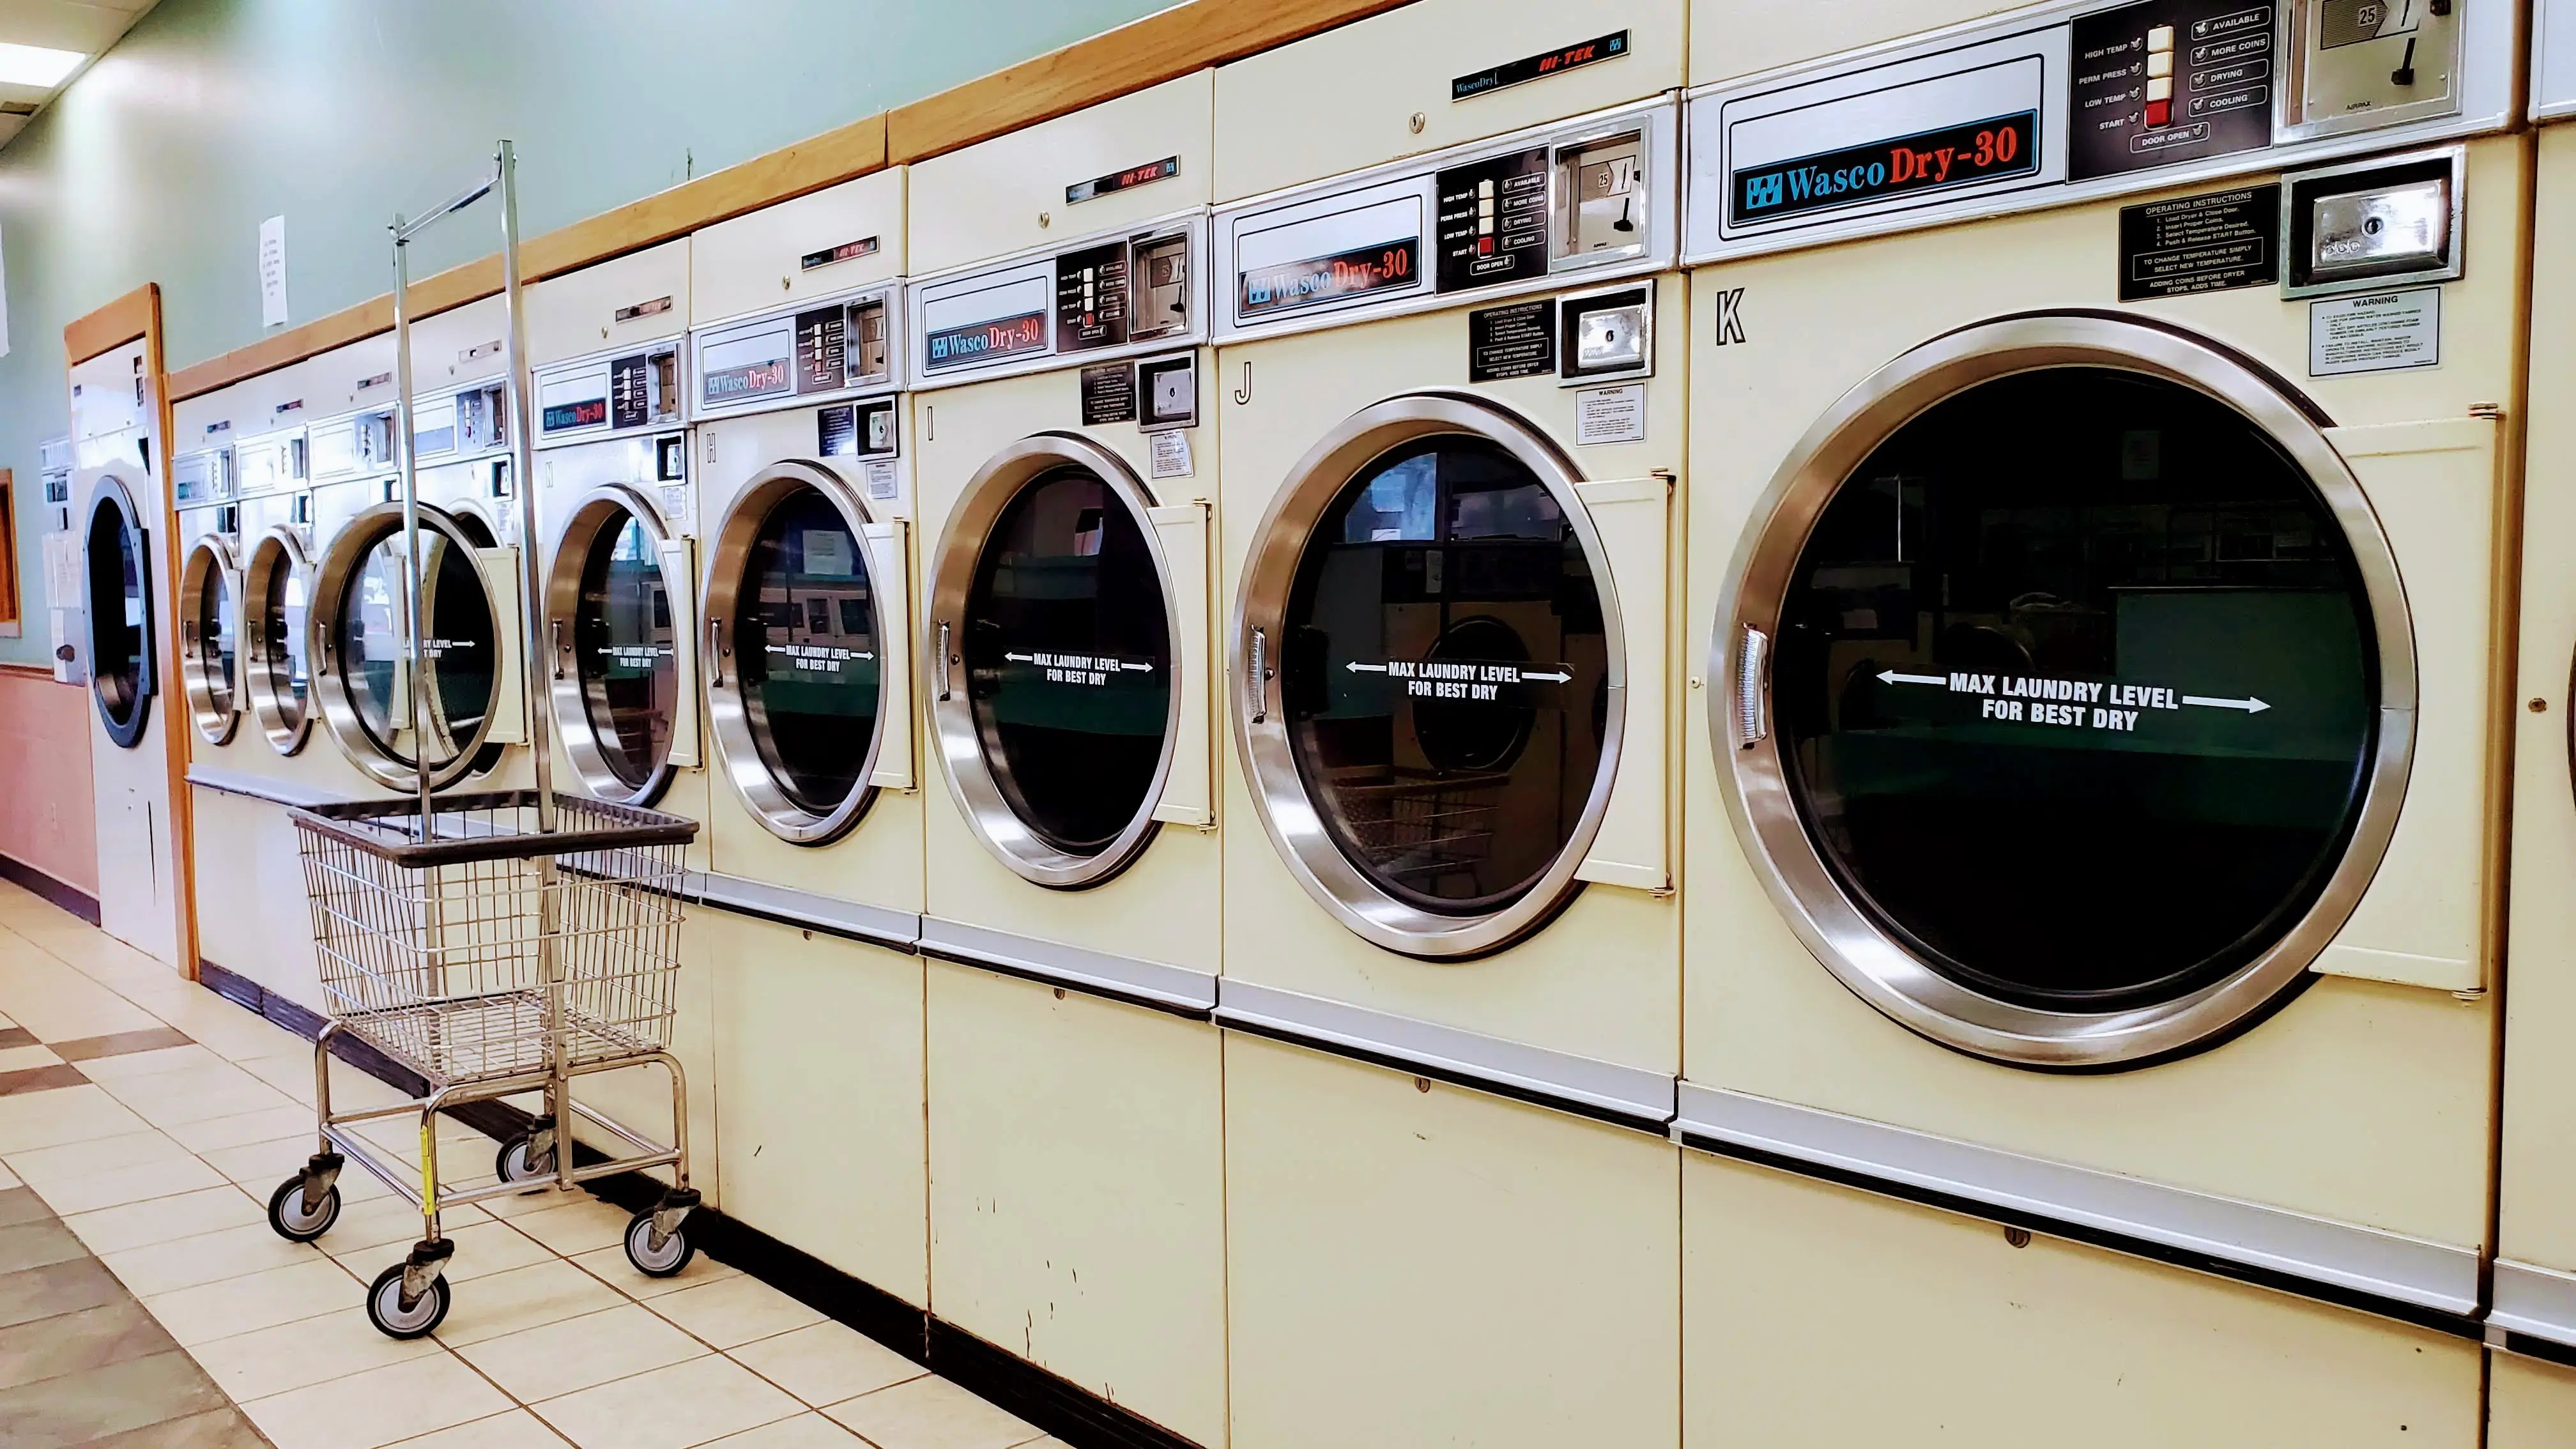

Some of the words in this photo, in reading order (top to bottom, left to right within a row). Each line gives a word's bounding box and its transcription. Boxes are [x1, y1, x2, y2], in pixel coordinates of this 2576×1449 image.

[2213, 13, 2259, 30] AVAILABLE
[2360, 8, 2375, 24] 25
[2085, 50, 2104, 59] HIGH
[2107, 44, 2128, 54] TEMP
[2211, 46, 2236, 56] MORE
[2239, 38, 2266, 50] COINS
[2079, 75, 2100, 84] PERM
[2103, 68, 2126, 79] PRESS
[2211, 69, 2242, 82] DRYING
[2085, 99, 2101, 107] LOW
[2104, 94, 2126, 103] TEMP
[2210, 95, 2248, 108] COOLING
[2099, 119, 2124, 130] START
[2142, 136, 2165, 146] DOOR
[2167, 131, 2189, 141] OPEN
[1514, 177, 1540, 187] AVAILABLE
[1600, 174, 1607, 186] 25
[2146, 201, 2189, 215] OPERATING
[2193, 192, 2252, 207] INSTRUCTIONS
[2186, 225, 2223, 236] Temperature
[2154, 255, 2180, 263] CHANGE
[2183, 249, 2227, 260] TEMPERATURE
[2196, 273, 2221, 282] BEFORE
[2353, 296, 2398, 307] WARNING
[1716, 288, 1746, 346] K
[1235, 362, 1251, 405] J
[707, 433, 716, 463] H
[433, 640, 452, 648] LEVEL
[786, 645, 800, 656] MAX
[801, 646, 830, 658] LAUNDRY
[831, 648, 850, 660] LEVEL
[796, 659, 808, 669] FOR
[810, 659, 825, 670] BEST
[827, 661, 840, 671] DRY
[1034, 653, 1052, 666] MAX
[1054, 654, 1092, 669] LAUNDRY
[1094, 657, 1120, 671] LEVEL
[1047, 669, 1062, 682] FOR
[1066, 670, 1086, 684] BEST
[1089, 673, 1106, 686] DRY
[1389, 661, 1415, 677] MAX
[1419, 664, 1477, 680] LAUNDRY
[1481, 666, 1520, 682] LEVEL
[1408, 680, 1432, 696] FOR
[1436, 682, 1468, 698] BEST
[1472, 684, 1498, 700] DRY
[1949, 672, 1994, 695] MAX
[2002, 676, 2103, 703] LAUNDRY
[2110, 684, 2179, 710] LEVEL
[1982, 700, 2023, 720] FOR
[2031, 703, 2086, 726] BEST
[2093, 709, 2138, 732] DRY
